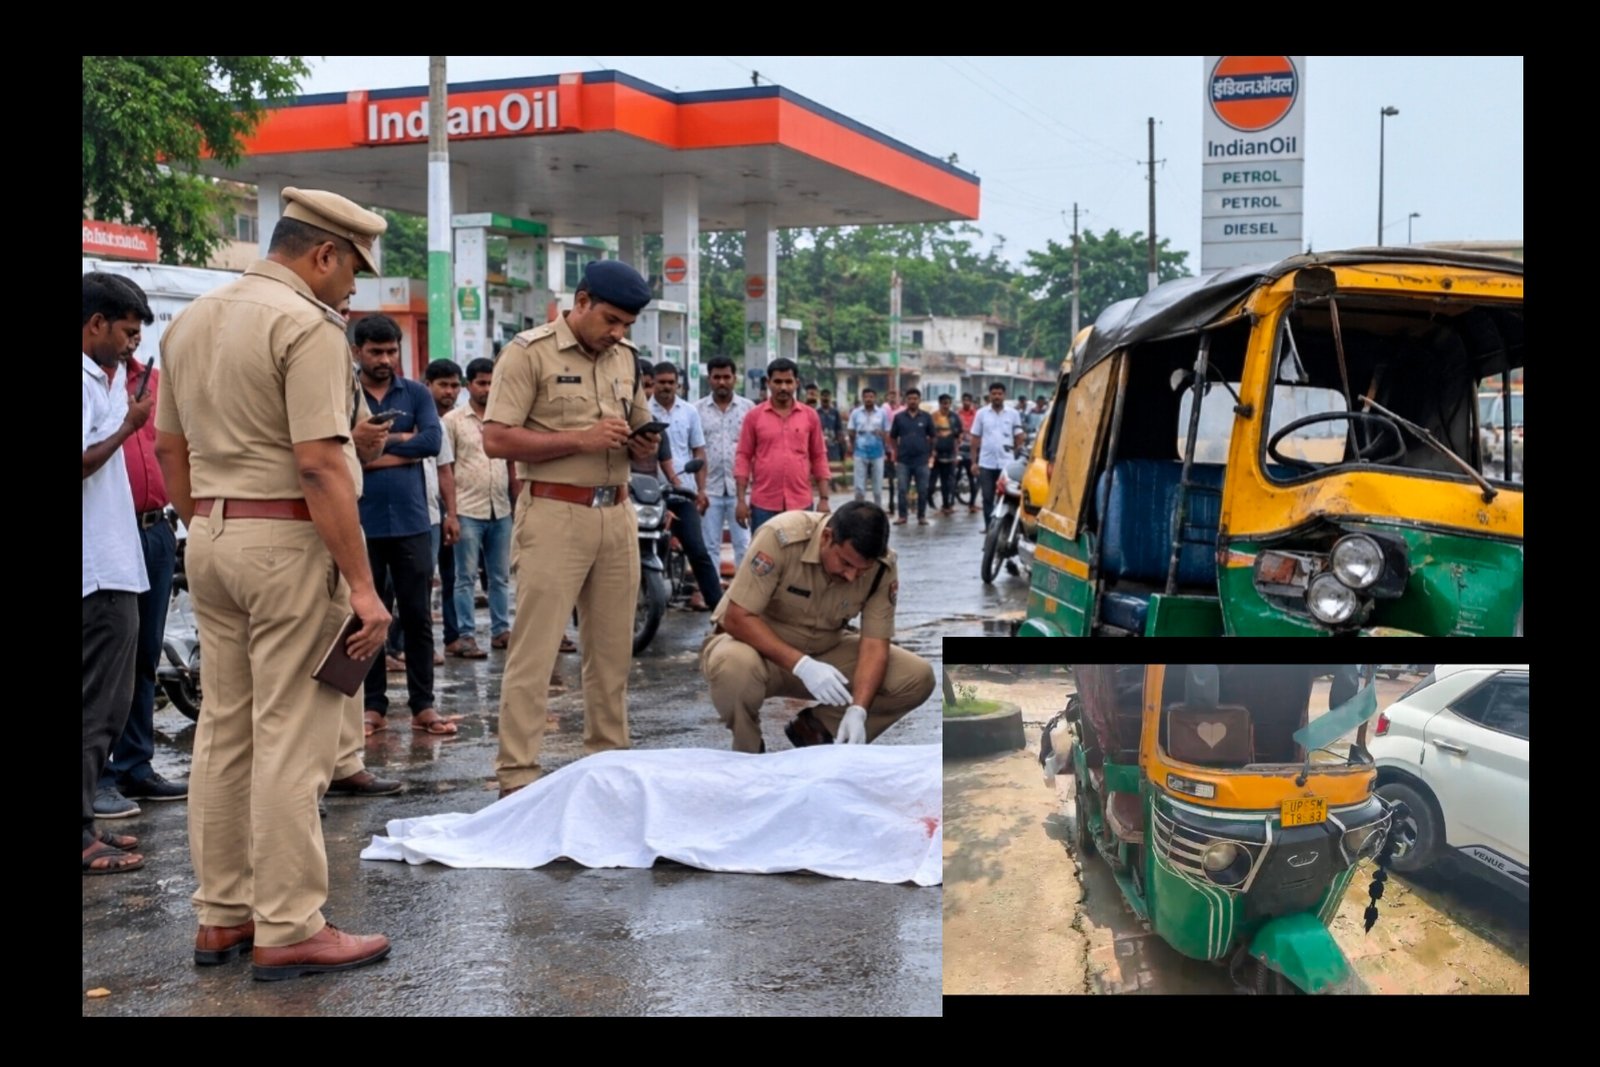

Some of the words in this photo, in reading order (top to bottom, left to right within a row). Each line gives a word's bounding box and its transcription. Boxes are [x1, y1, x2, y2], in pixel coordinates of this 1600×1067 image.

[367, 90, 559, 141] IndanOil
[1208, 137, 1297, 157] IndianOil
[1222, 171, 1282, 184] PETROL
[1222, 196, 1282, 209] PETROL
[1224, 223, 1278, 236] DIESEL
[1473, 849, 1506, 871] VENUE
